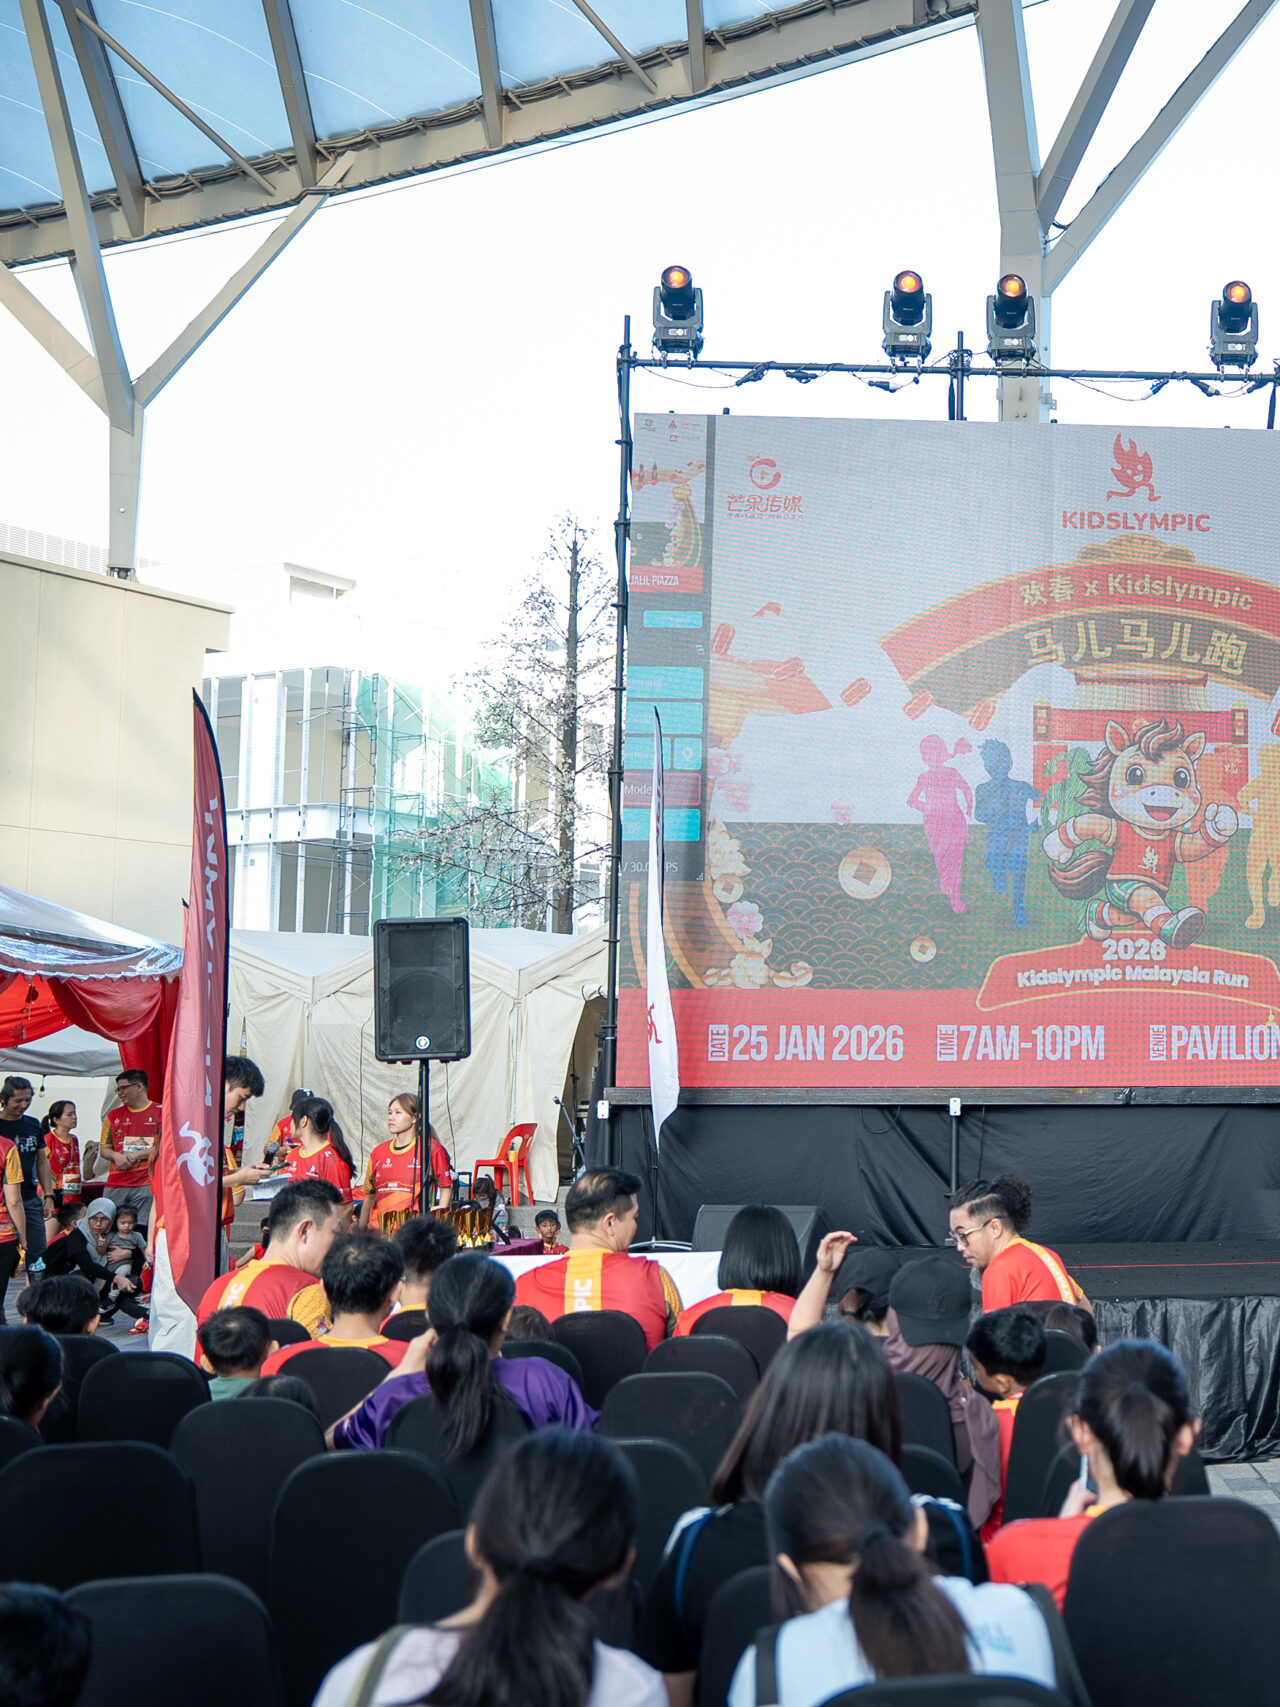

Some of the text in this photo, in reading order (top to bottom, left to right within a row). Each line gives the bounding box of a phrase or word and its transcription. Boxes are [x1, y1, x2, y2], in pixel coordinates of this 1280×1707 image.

[1061, 511, 1211, 532] KIDSLYMPIC
[652, 575, 679, 586] PIAZZA
[1021, 575, 1075, 607] 欢春
[1107, 573, 1254, 610] Kidslympic
[1023, 618, 1248, 676] 马儿马儿跑
[1101, 938, 1167, 961] 2026
[1017, 964, 1249, 988] Kidslympic Malaysia Run
[710, 1026, 728, 1059] DATE
[732, 1024, 904, 1062] 25 JAN 2026
[938, 1027, 956, 1059] TIME
[959, 1024, 1105, 1061] 7AM-10PM
[1151, 1026, 1166, 1059] VENUE
